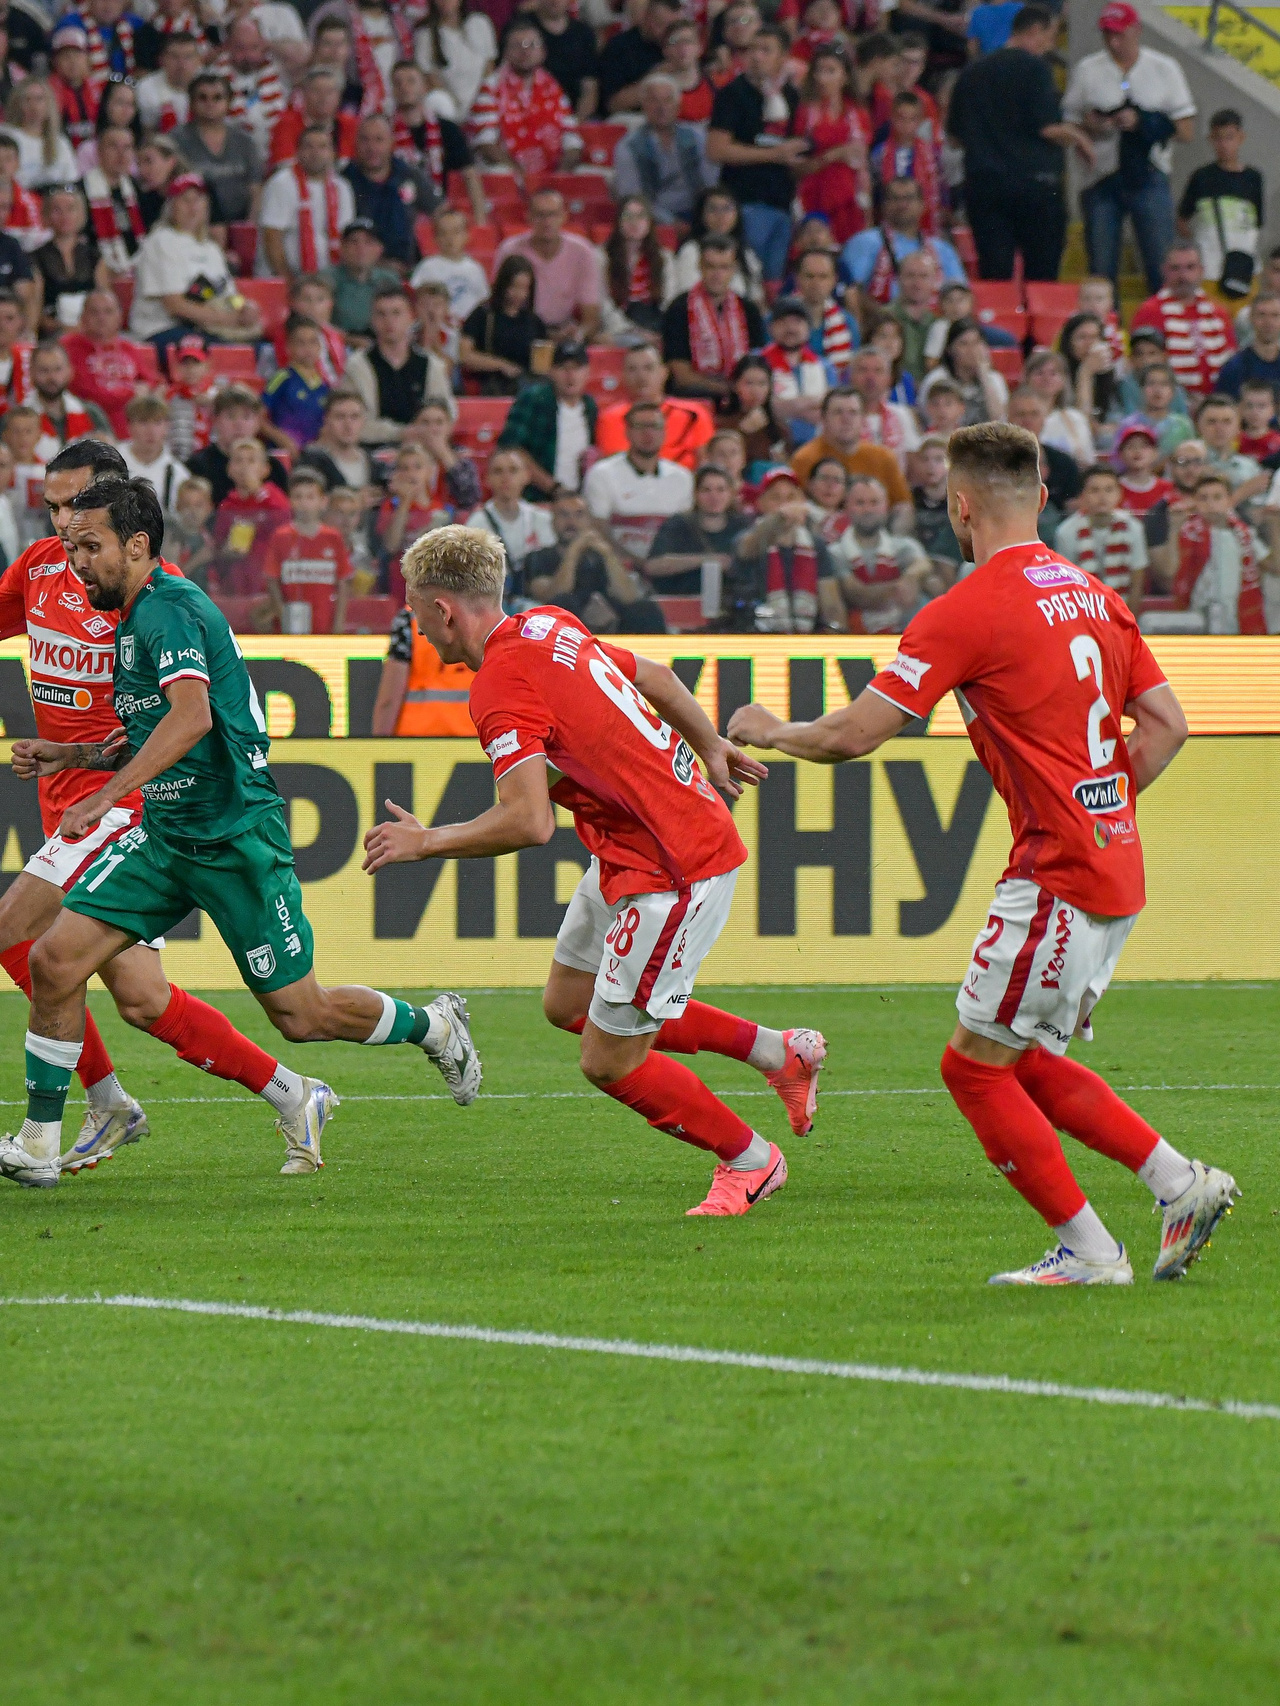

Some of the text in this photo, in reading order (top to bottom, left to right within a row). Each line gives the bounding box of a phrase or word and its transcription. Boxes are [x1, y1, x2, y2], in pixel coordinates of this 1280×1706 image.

[1036, 590, 1111, 627] РЯБЧУК
[32, 684, 71, 704] Winline
[1069, 634, 1116, 770] 2
[496, 740, 514, 751] Банк
[973, 914, 1005, 971] 2
